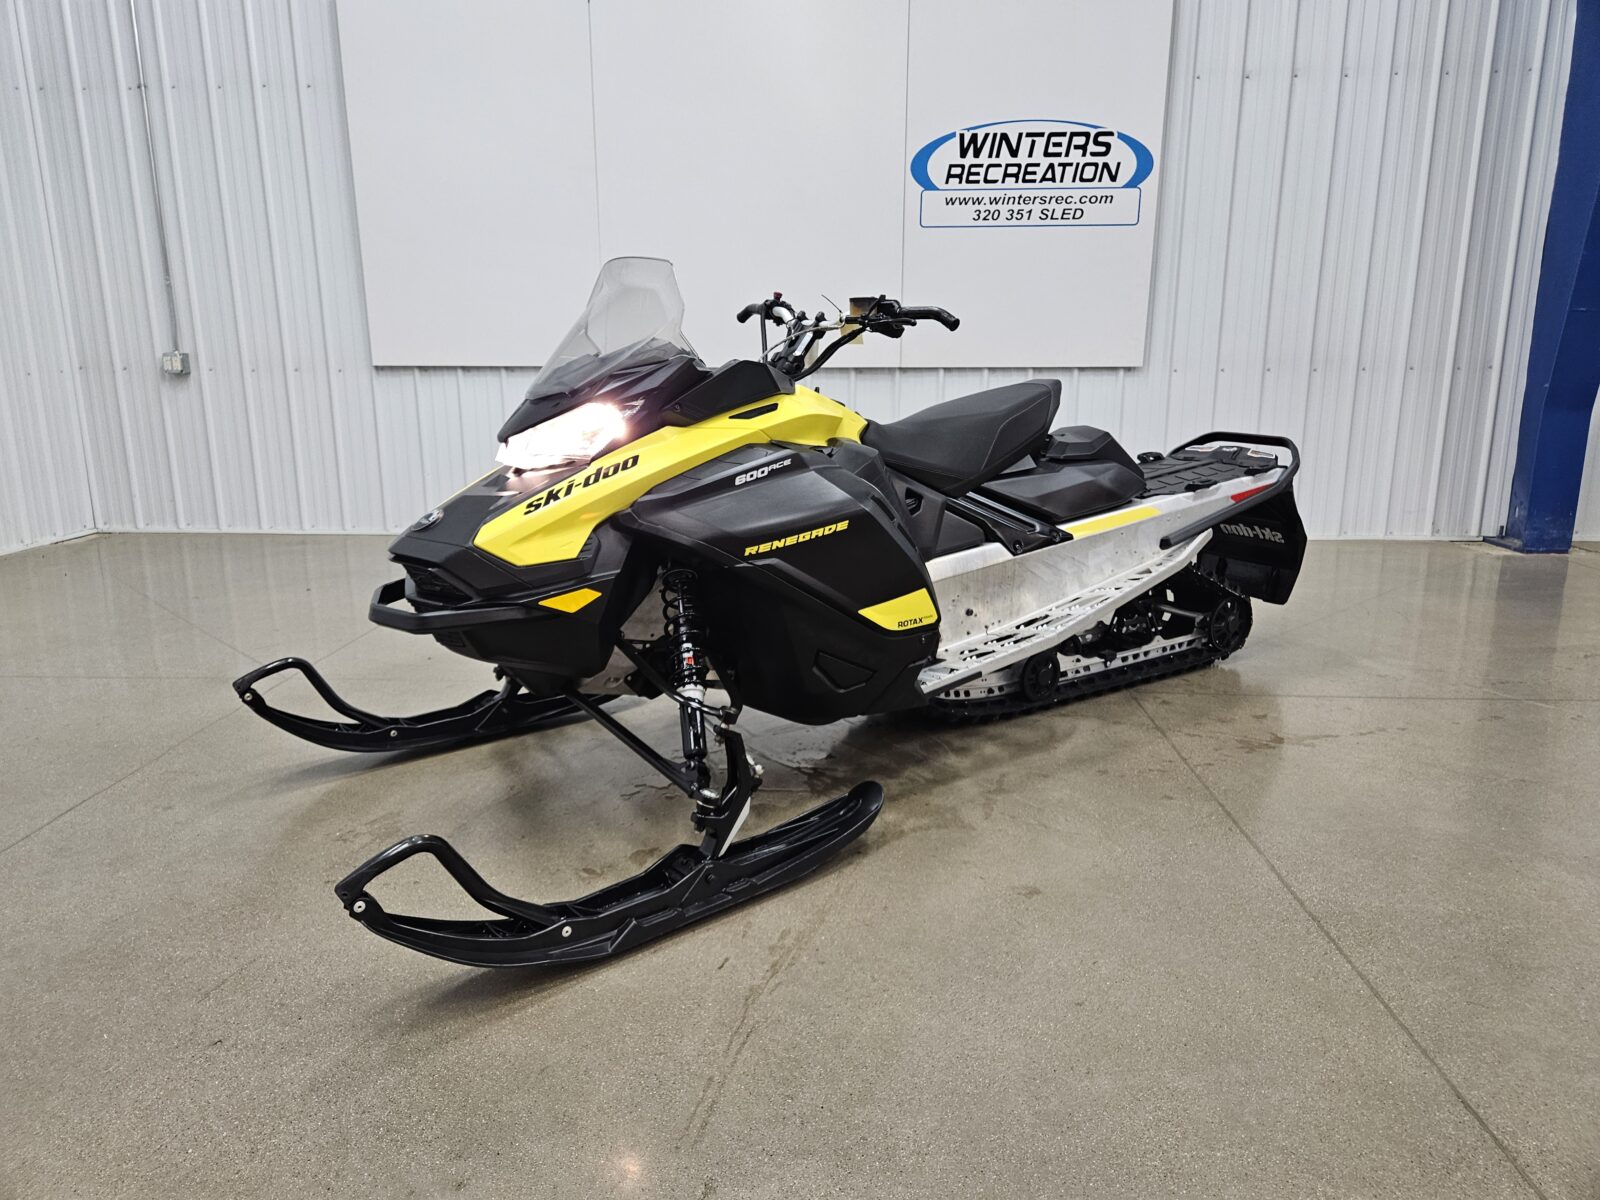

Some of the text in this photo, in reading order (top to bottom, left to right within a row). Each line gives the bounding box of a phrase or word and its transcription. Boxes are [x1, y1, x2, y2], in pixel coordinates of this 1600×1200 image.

[958, 131, 1115, 159] WINTERS
[944, 161, 1122, 185] RECREATION
[944, 193, 1114, 206] www.wintersrec.com
[972, 208, 1085, 221] 320 351 SLED
[523, 454, 640, 516] ski-doo
[743, 519, 850, 557] RENEGADE
[897, 617, 924, 629] ROTAX
